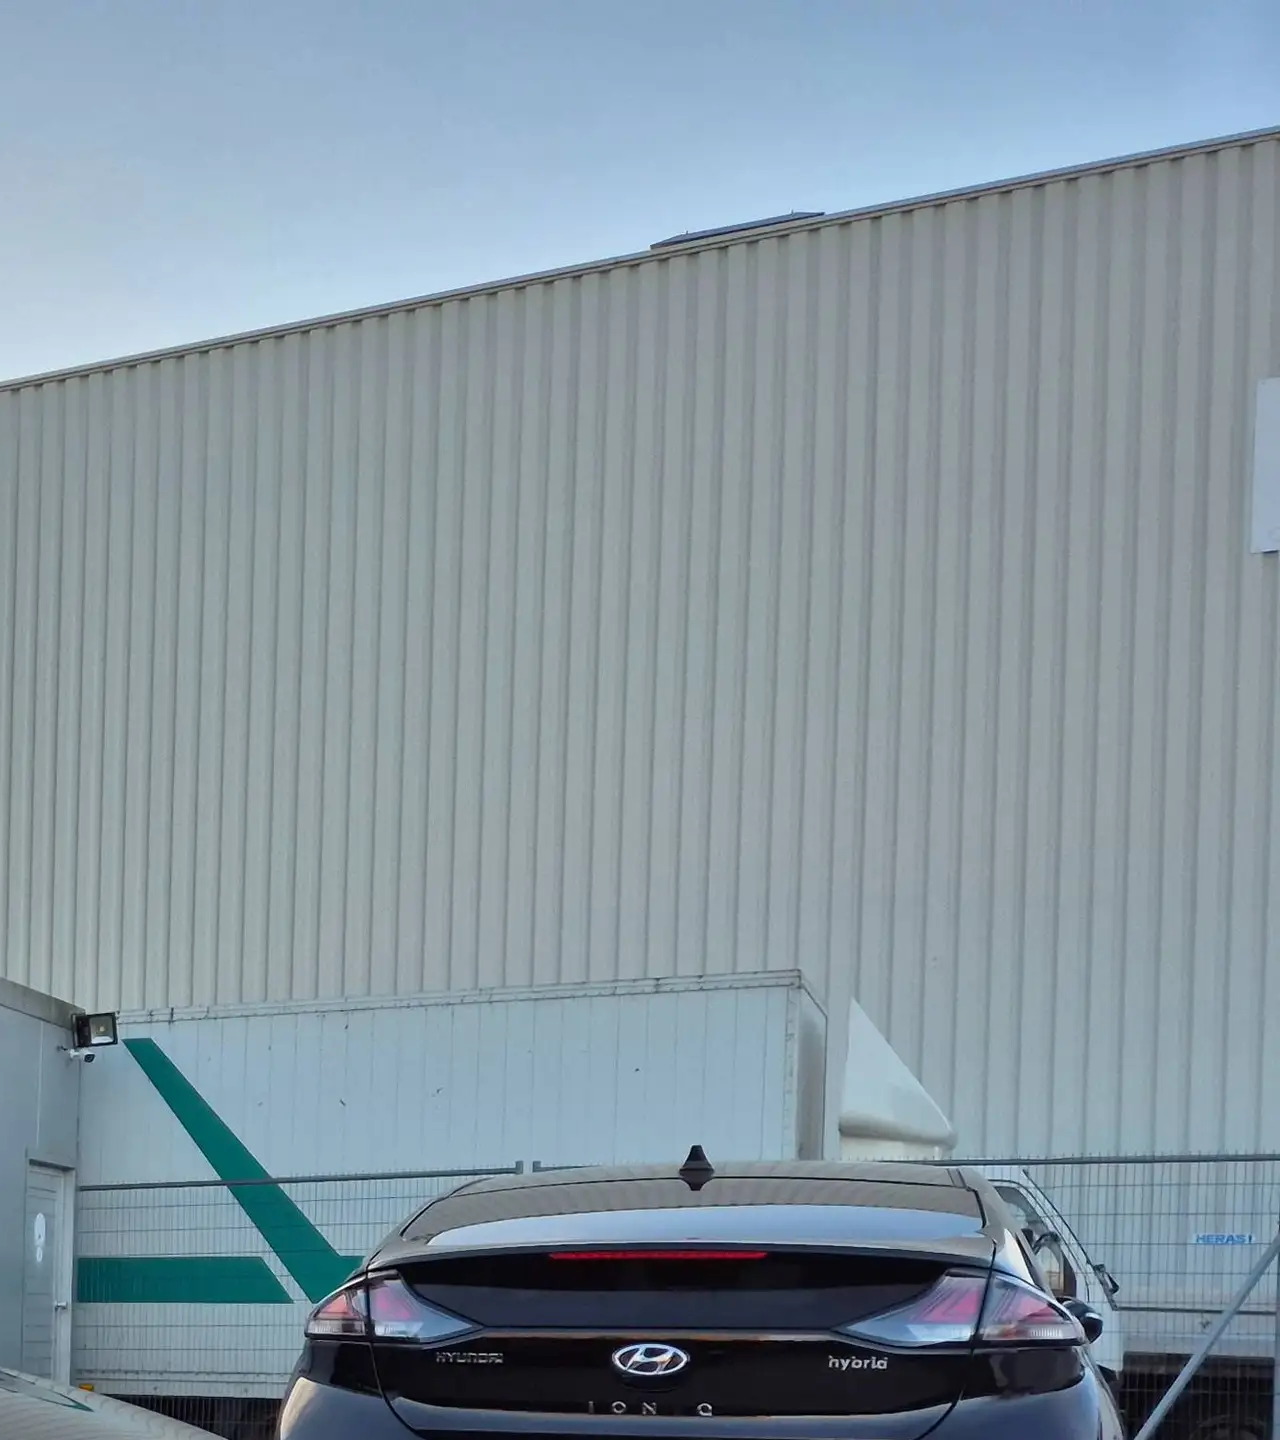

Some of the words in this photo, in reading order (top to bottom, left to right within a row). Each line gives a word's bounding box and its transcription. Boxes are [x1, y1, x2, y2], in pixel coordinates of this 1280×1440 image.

[435, 1352, 504, 1364] HYUNDAI
[828, 1354, 889, 1372] hybrid
[587, 1400, 714, 1417] IONQ
